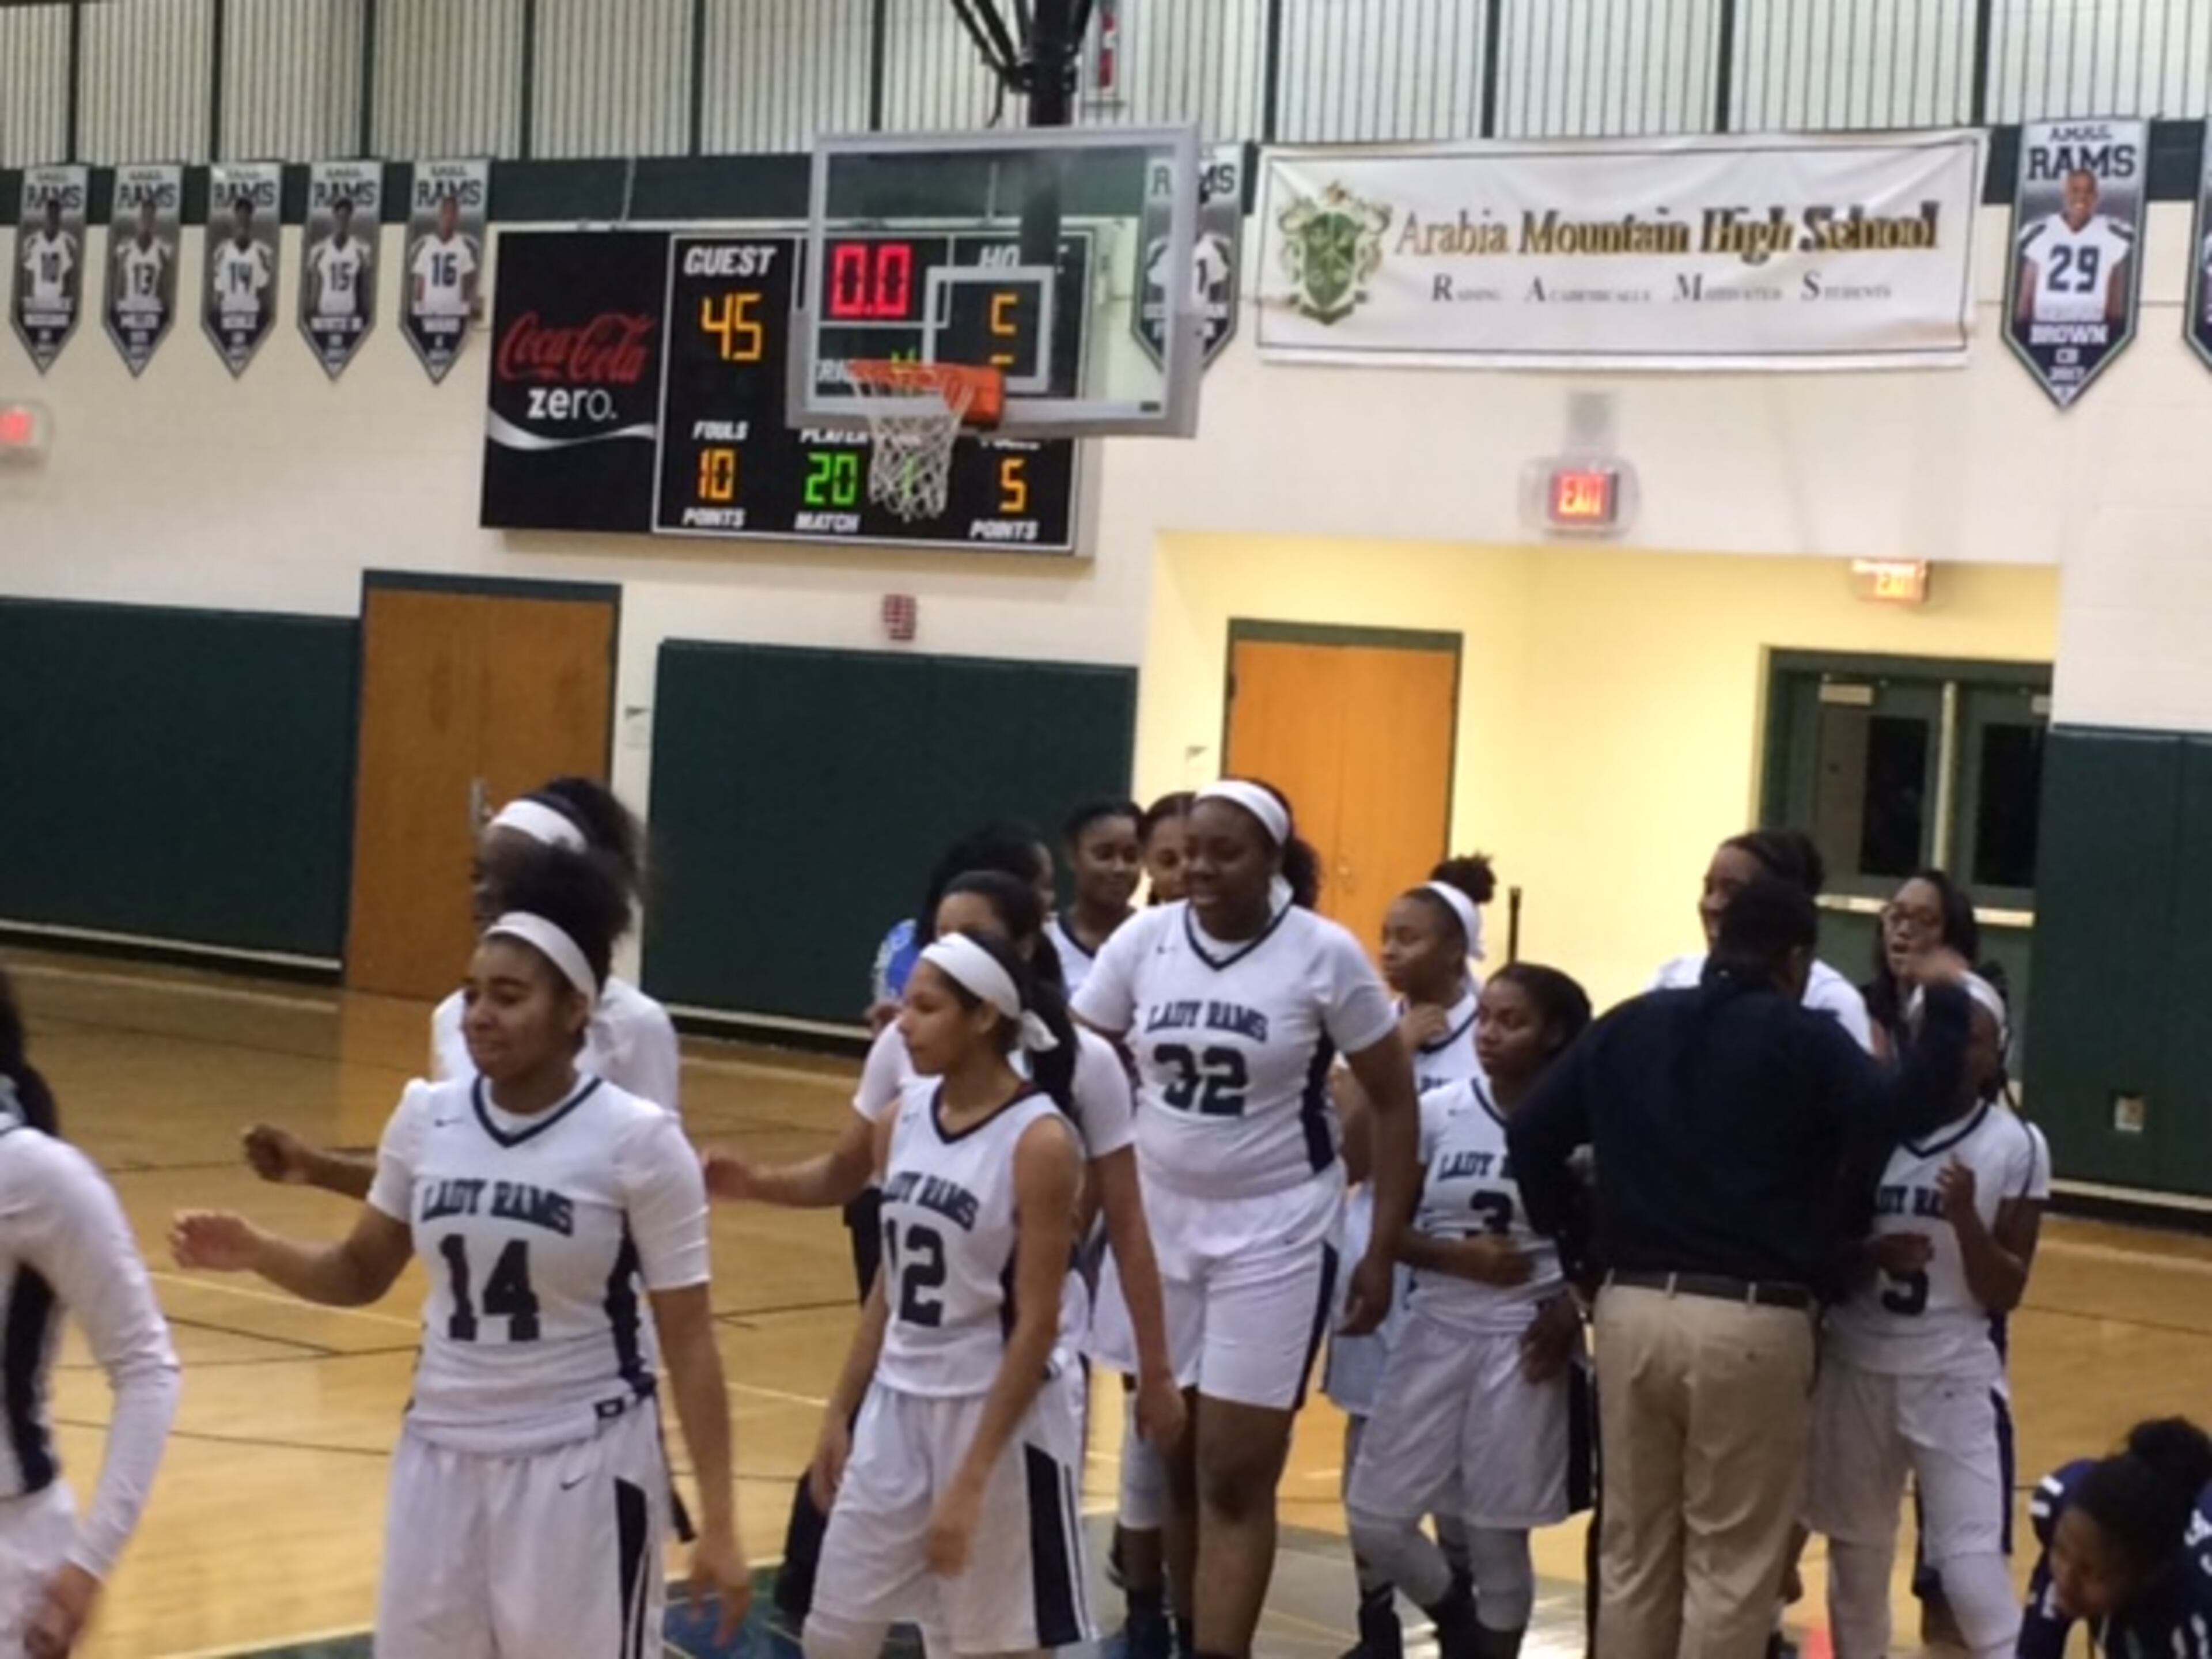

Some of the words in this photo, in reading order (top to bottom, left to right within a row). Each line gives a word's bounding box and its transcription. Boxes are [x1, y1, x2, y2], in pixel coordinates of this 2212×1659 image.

[2027, 144, 2136, 181] RAMS
[26, 184, 82, 209] RAMS
[119, 183, 176, 209] RAMS
[214, 183, 275, 208] RAMS
[313, 181, 376, 207] RAMS
[416, 180, 482, 207] RAMS
[1394, 209, 1509, 255] Arabia
[1519, 207, 1689, 255] Mountain
[1699, 204, 1794, 266] High
[1798, 200, 1940, 253] School
[329, 262, 353, 292] 15
[431, 252, 458, 287] 16
[683, 246, 777, 276] GUEST
[2046, 244, 2100, 293] 29
[701, 293, 763, 361] 45
[693, 421, 748, 440] FOULS
[698, 448, 736, 501] 10
[804, 452, 858, 505] 20
[998, 457, 1026, 512] 5
[682, 508, 745, 529] POINTS
[794, 512, 861, 533] MATCH
[969, 520, 1039, 541] POINTS
[1145, 1001, 1202, 1033] LADY
[1206, 1001, 1269, 1044] RAMS
[1154, 1043, 1249, 1116] 32
[1438, 1152, 1495, 1182] LADY
[421, 1178, 487, 1223] LADY
[490, 1181, 574, 1238] RAMS
[439, 1233, 540, 1342] 14
